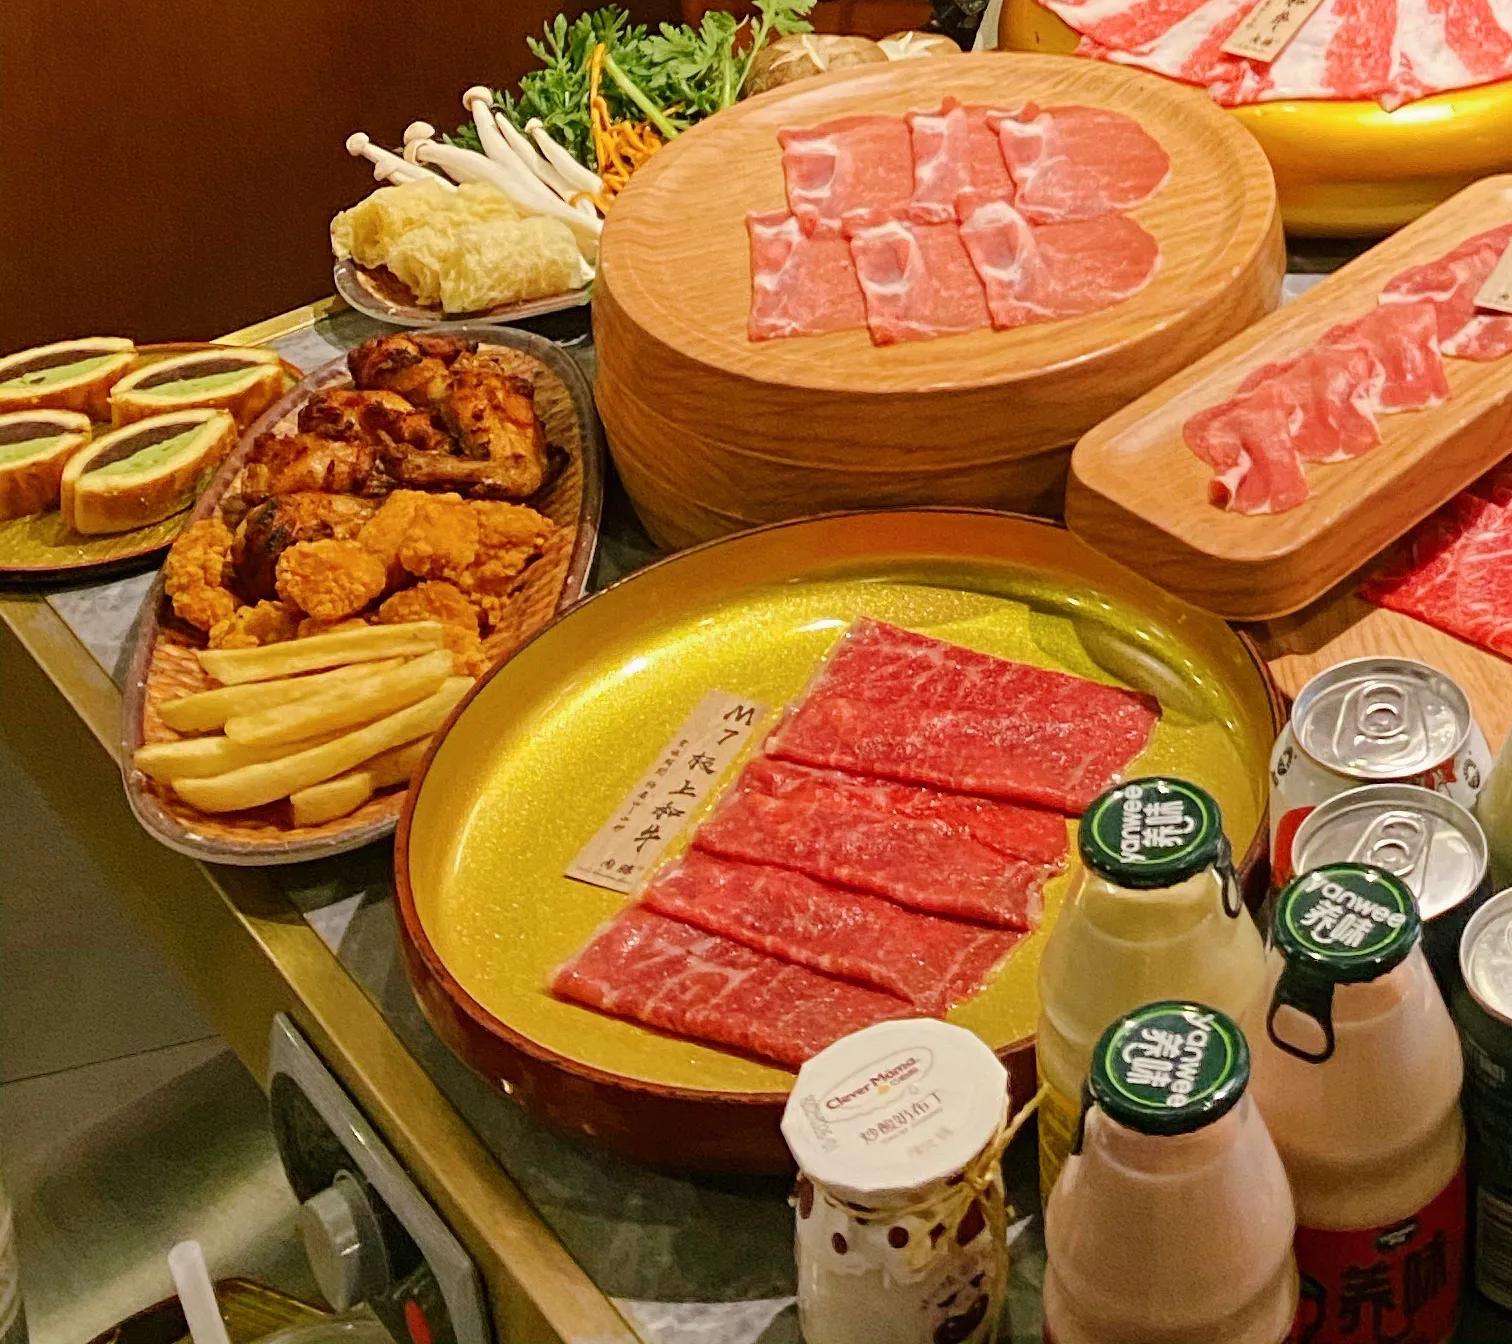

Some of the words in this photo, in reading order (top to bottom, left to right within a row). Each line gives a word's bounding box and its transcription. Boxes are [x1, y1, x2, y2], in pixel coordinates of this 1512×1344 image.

[1120, 784, 1146, 863] yanwee
[1141, 800, 1195, 847] 养味
[1300, 899, 1374, 947] 养味
[826, 1082, 871, 1110] Clever
[871, 1057, 917, 1088] Mama
[1122, 1028, 1184, 1088] 养味
[1165, 1011, 1215, 1108] yanwee
